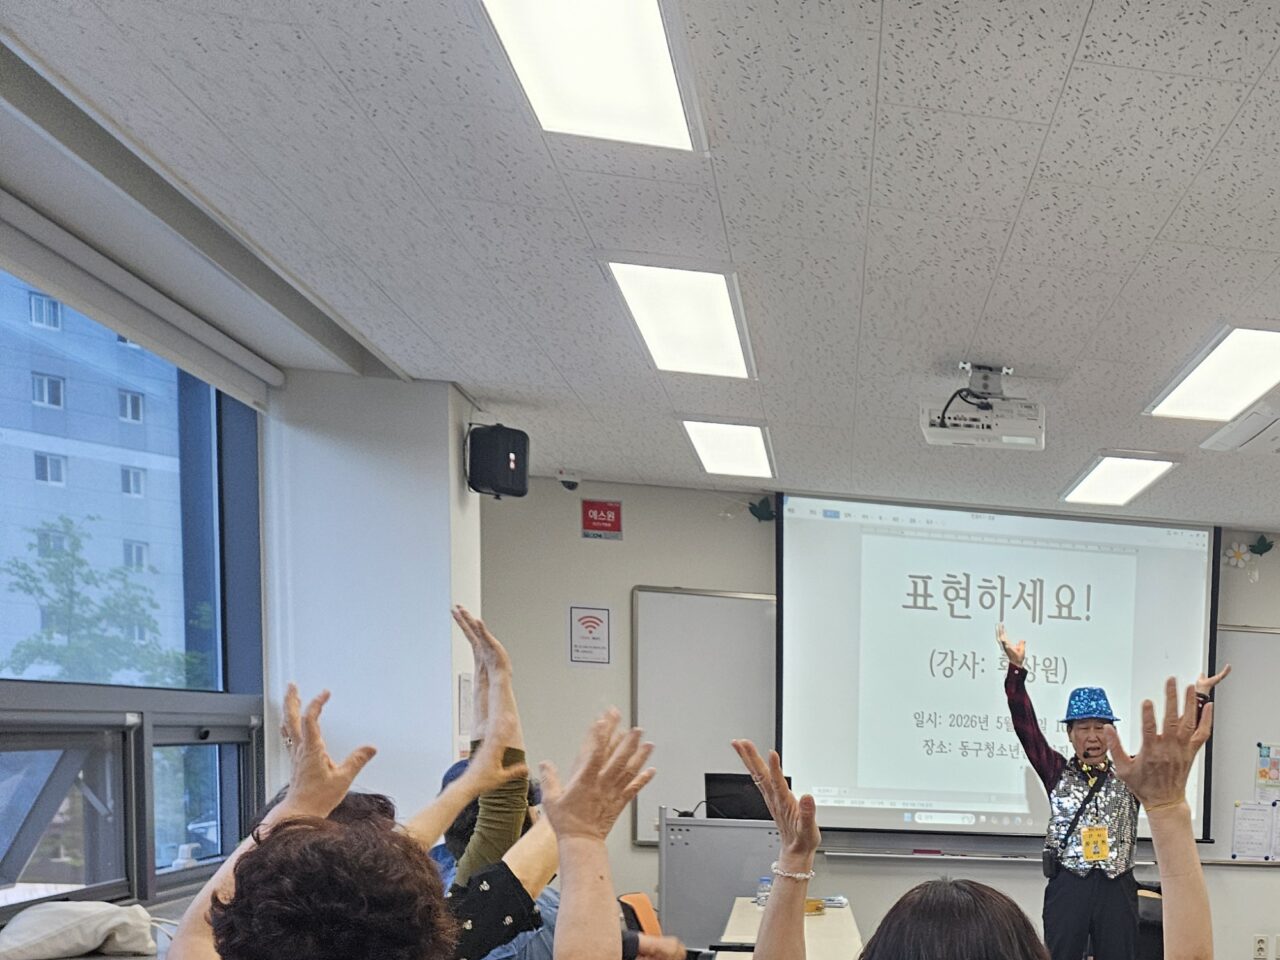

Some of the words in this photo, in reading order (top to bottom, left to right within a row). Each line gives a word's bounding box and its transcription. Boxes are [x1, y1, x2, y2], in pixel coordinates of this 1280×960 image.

[901, 572, 1092, 625] 표현하세요!
[929, 648, 985, 679] (강사:
[913, 711, 942, 729] 일시:
[948, 713, 989, 731] 2026년
[923, 739, 952, 756] 장소:
